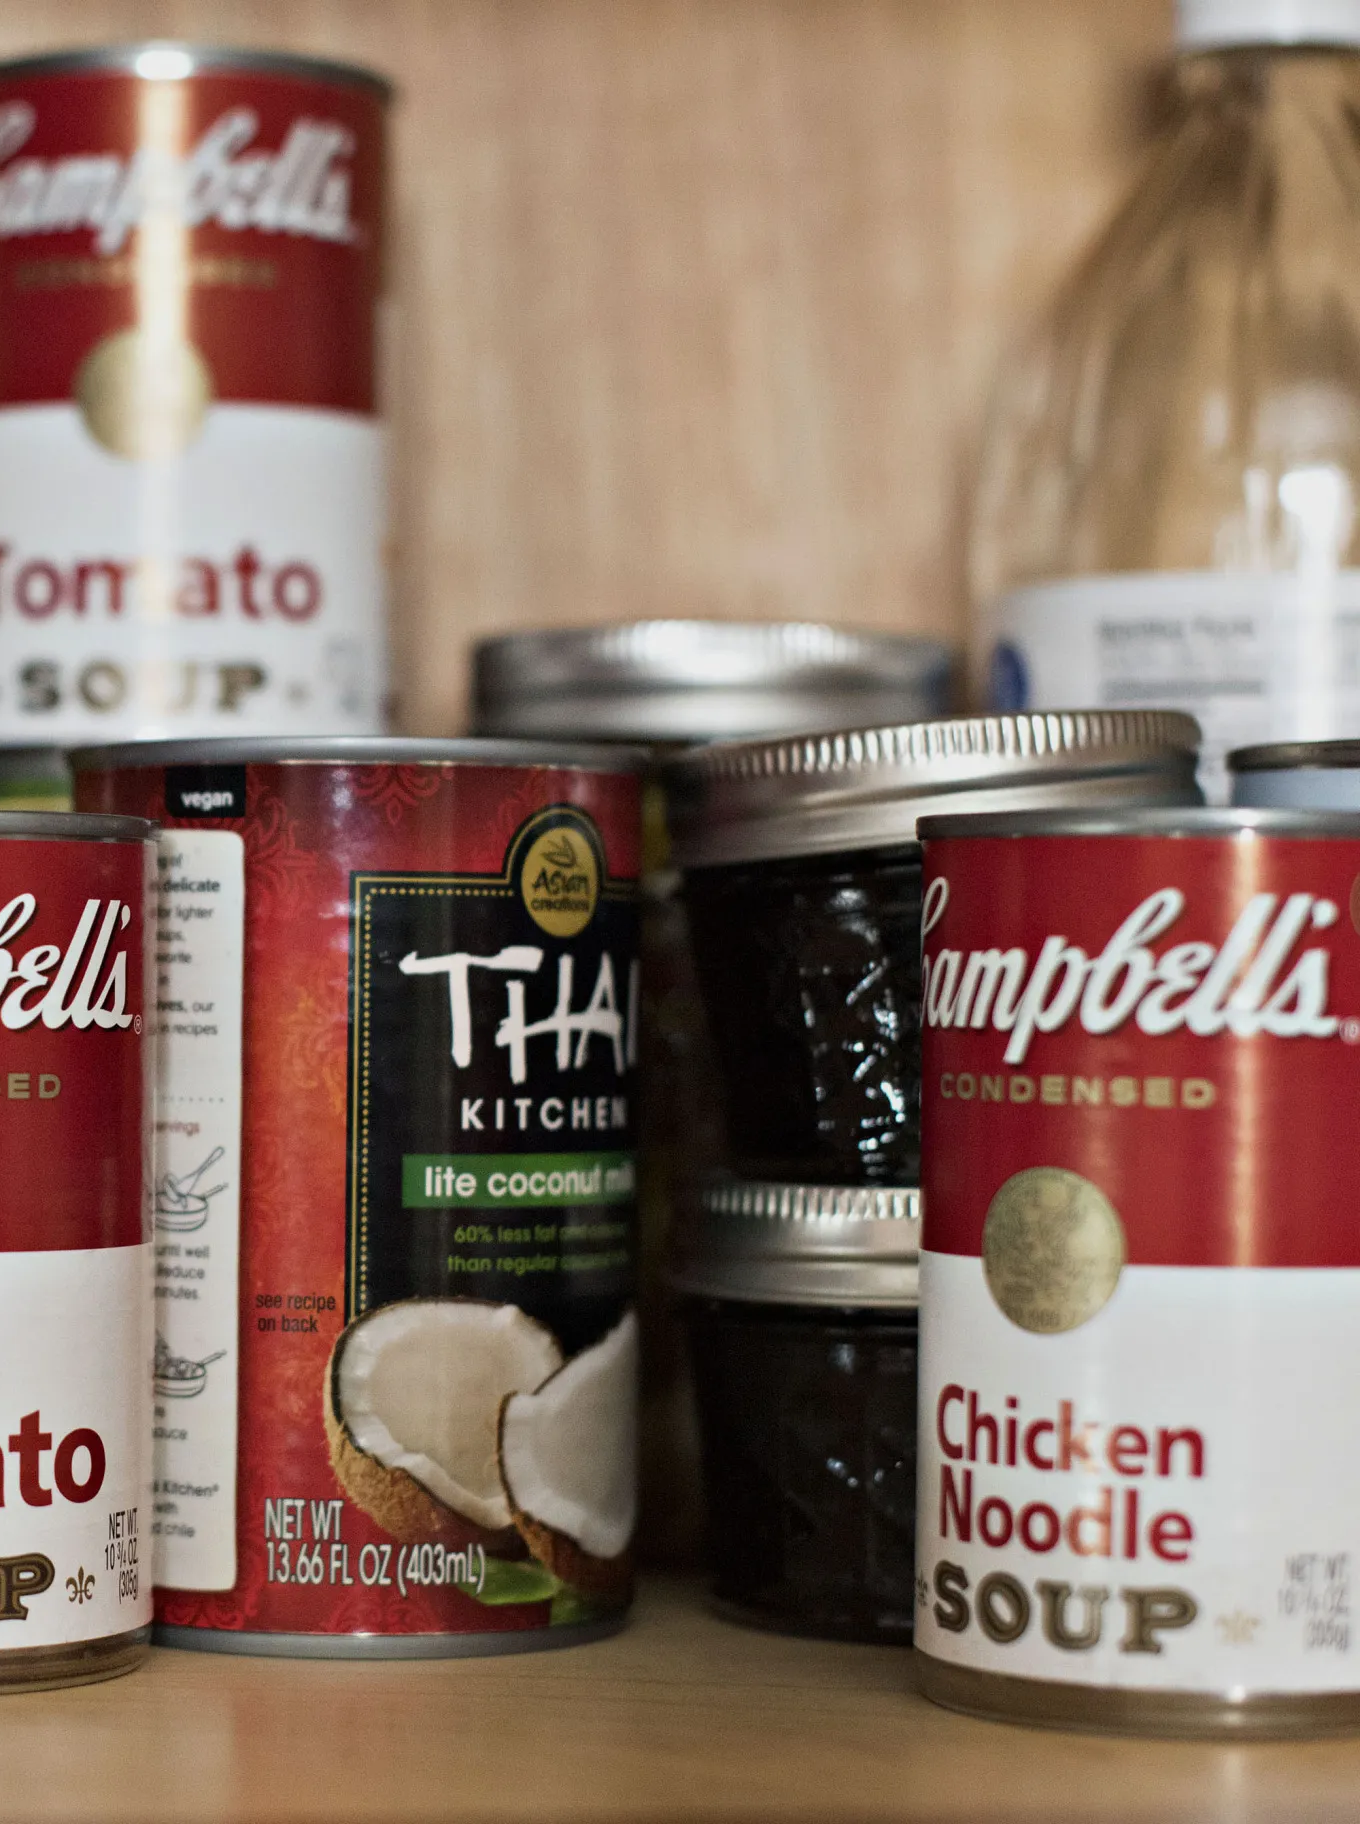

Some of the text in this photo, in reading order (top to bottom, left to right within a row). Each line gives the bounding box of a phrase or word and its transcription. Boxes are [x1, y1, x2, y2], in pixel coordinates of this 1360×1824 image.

[181, 791, 234, 811] vegan
[162, 876, 221, 892] delicate
[175, 903, 213, 922] lighter
[192, 1002, 215, 1013] our
[400, 946, 639, 1086] THAI
[173, 1023, 219, 1041] recipes
[941, 1073, 1217, 1109] CONDENSED
[462, 1098, 628, 1132] KITCHEN
[425, 1166, 477, 1198] lite
[487, 1163, 601, 1198] coconut
[454, 1225, 493, 1243] 60%
[497, 1225, 532, 1243] less
[535, 1224, 557, 1242] fat
[185, 1246, 209, 1258] well
[447, 1255, 492, 1272] than
[496, 1254, 558, 1276] regular
[256, 1292, 336, 1313] see recipe
[258, 1313, 318, 1332] on back
[936, 1383, 1206, 1478] Chicken
[109, 1511, 126, 1541] NET
[265, 1498, 344, 1541] NET WT
[940, 1464, 1195, 1563] Noodle
[105, 1543, 116, 1571] 10
[267, 1541, 485, 1598] 13.66 FL OZ (403mL)
[933, 1558, 1198, 1656] SOUP
